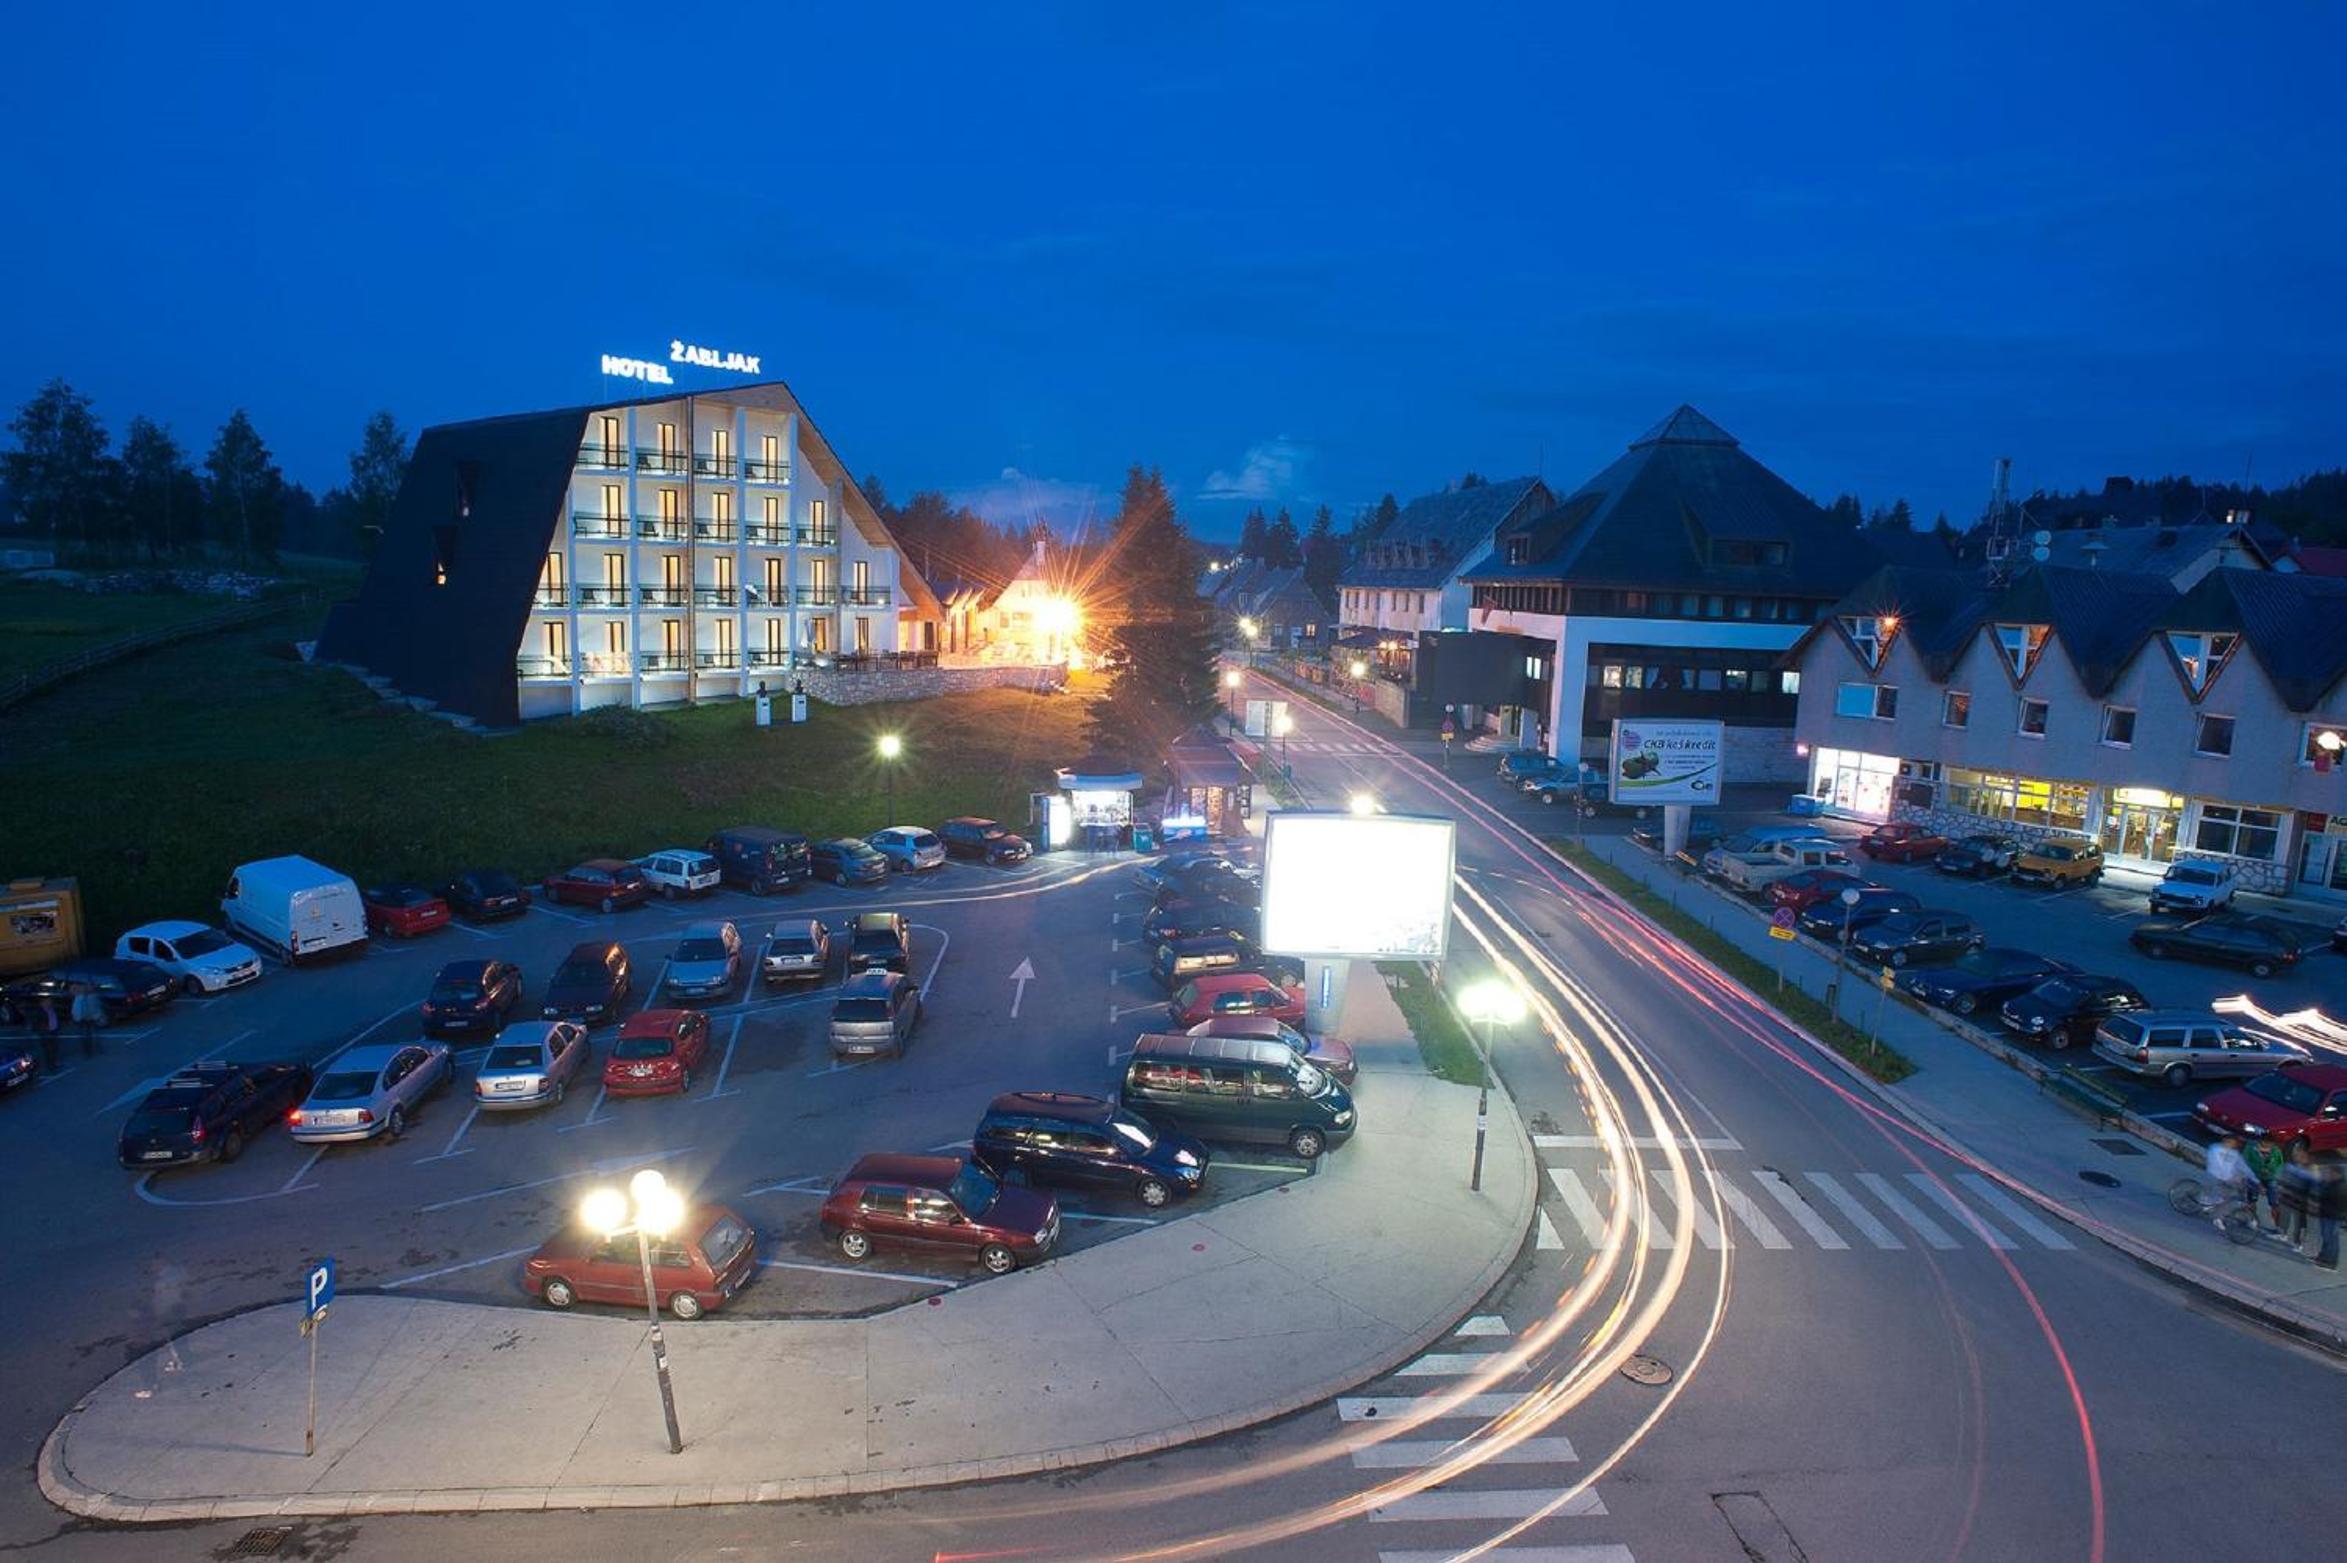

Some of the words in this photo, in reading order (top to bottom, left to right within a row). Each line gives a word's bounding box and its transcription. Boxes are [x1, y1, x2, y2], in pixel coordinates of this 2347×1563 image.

[602, 354, 674, 384] HOTEL
[670, 339, 761, 374] ŽABLJAK
[311, 1267, 328, 1310] P
